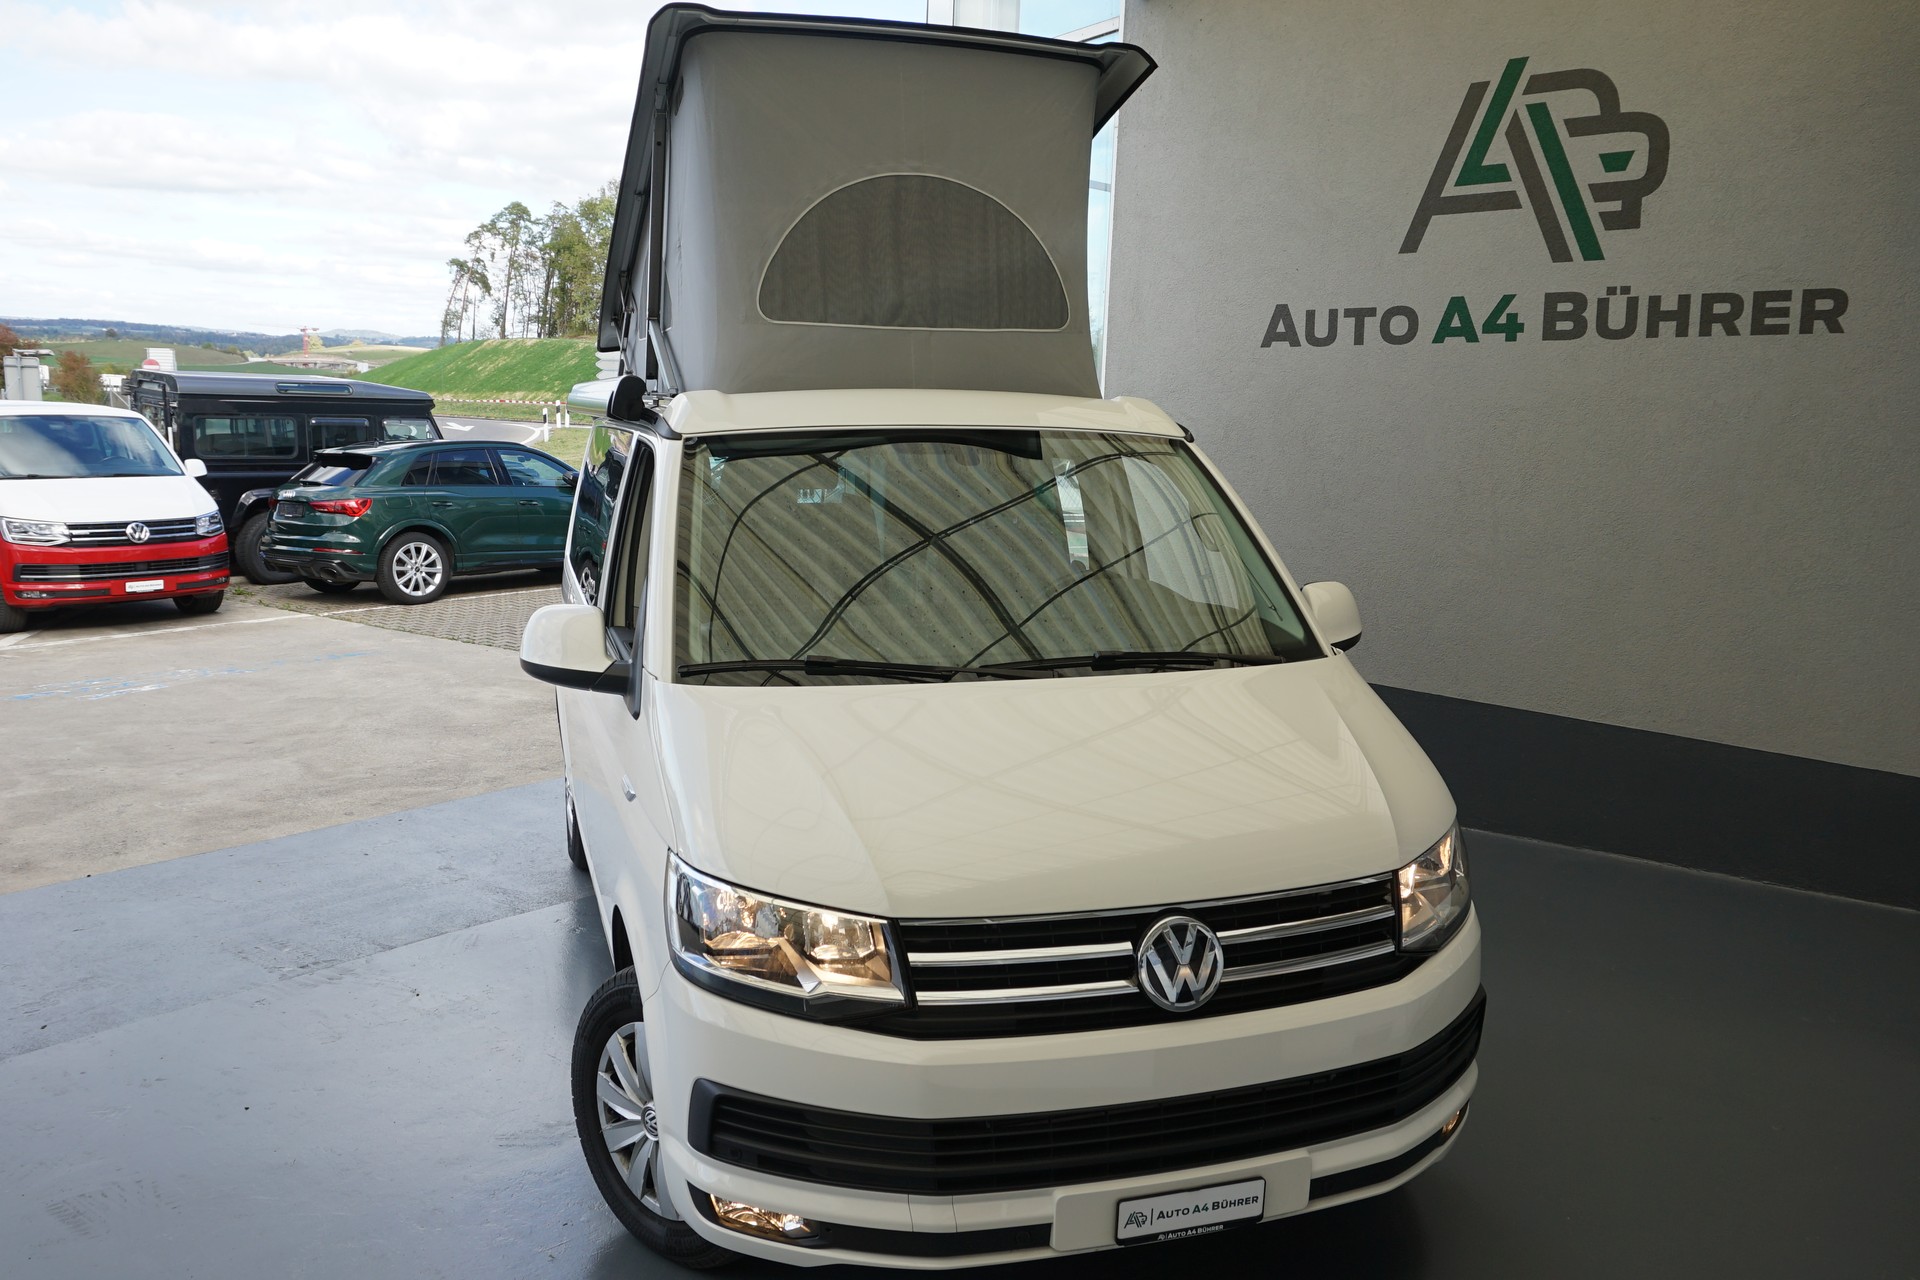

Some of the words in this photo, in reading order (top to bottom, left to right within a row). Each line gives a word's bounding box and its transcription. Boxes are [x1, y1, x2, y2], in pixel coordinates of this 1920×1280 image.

[1260, 303, 1419, 348] AUTO
[1431, 294, 1525, 344] A4
[1542, 285, 1849, 341] BÜHRER
[1138, 916, 1224, 1012] VW
[1157, 1207, 1190, 1220] AUTO
[1192, 1203, 1209, 1214] A4
[1212, 1195, 1259, 1211] BÜHRER
[1167, 1231, 1187, 1239] AUTO
[1187, 1227, 1197, 1236] A4
[1197, 1224, 1224, 1234] BÜHRER
